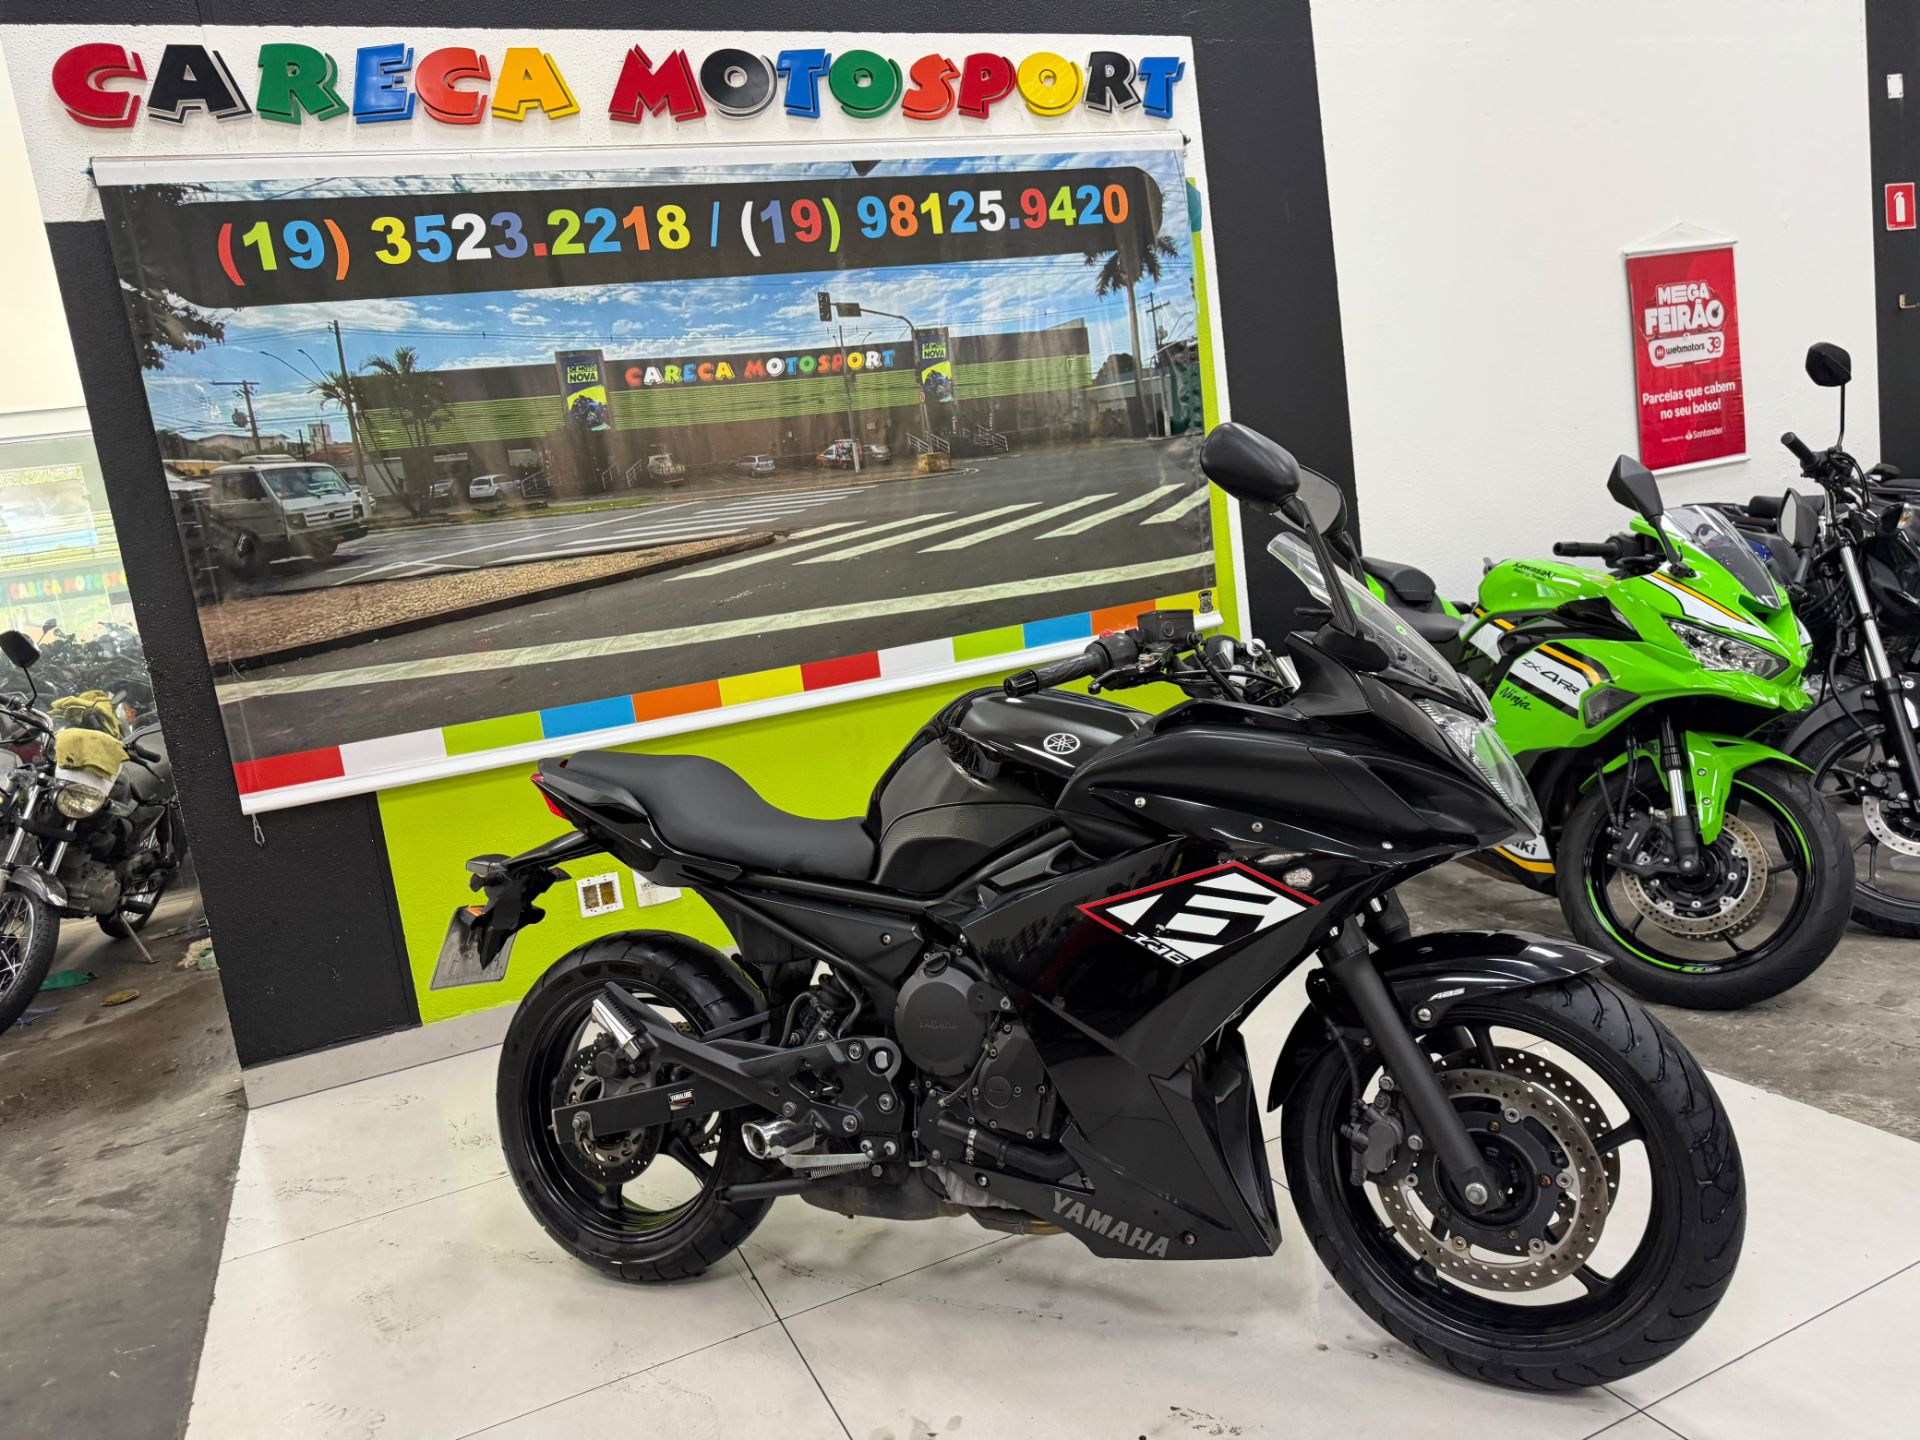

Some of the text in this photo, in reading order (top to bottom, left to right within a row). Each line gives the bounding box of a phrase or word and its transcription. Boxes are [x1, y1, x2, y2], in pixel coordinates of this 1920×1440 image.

[52, 42, 1185, 127] CARECA MOTOSPORT
[217, 184, 1129, 286] (19) 3523.2218 / (19) 98125.9420
[1657, 282, 1710, 306] MEGA
[1644, 299, 1724, 336] FEIRÃO
[1665, 342, 1705, 355] webmotors
[569, 372, 597, 382] NOVA
[624, 349, 896, 387] CARECA MOTOSPORT
[1642, 381, 1736, 406] Parcelas que cabem
[1660, 397, 1722, 420] no seu bolso!
[1692, 427, 1723, 439] Santander
[1500, 686, 1532, 711] Ninja
[1052, 1191, 1170, 1258] YAMAHA
